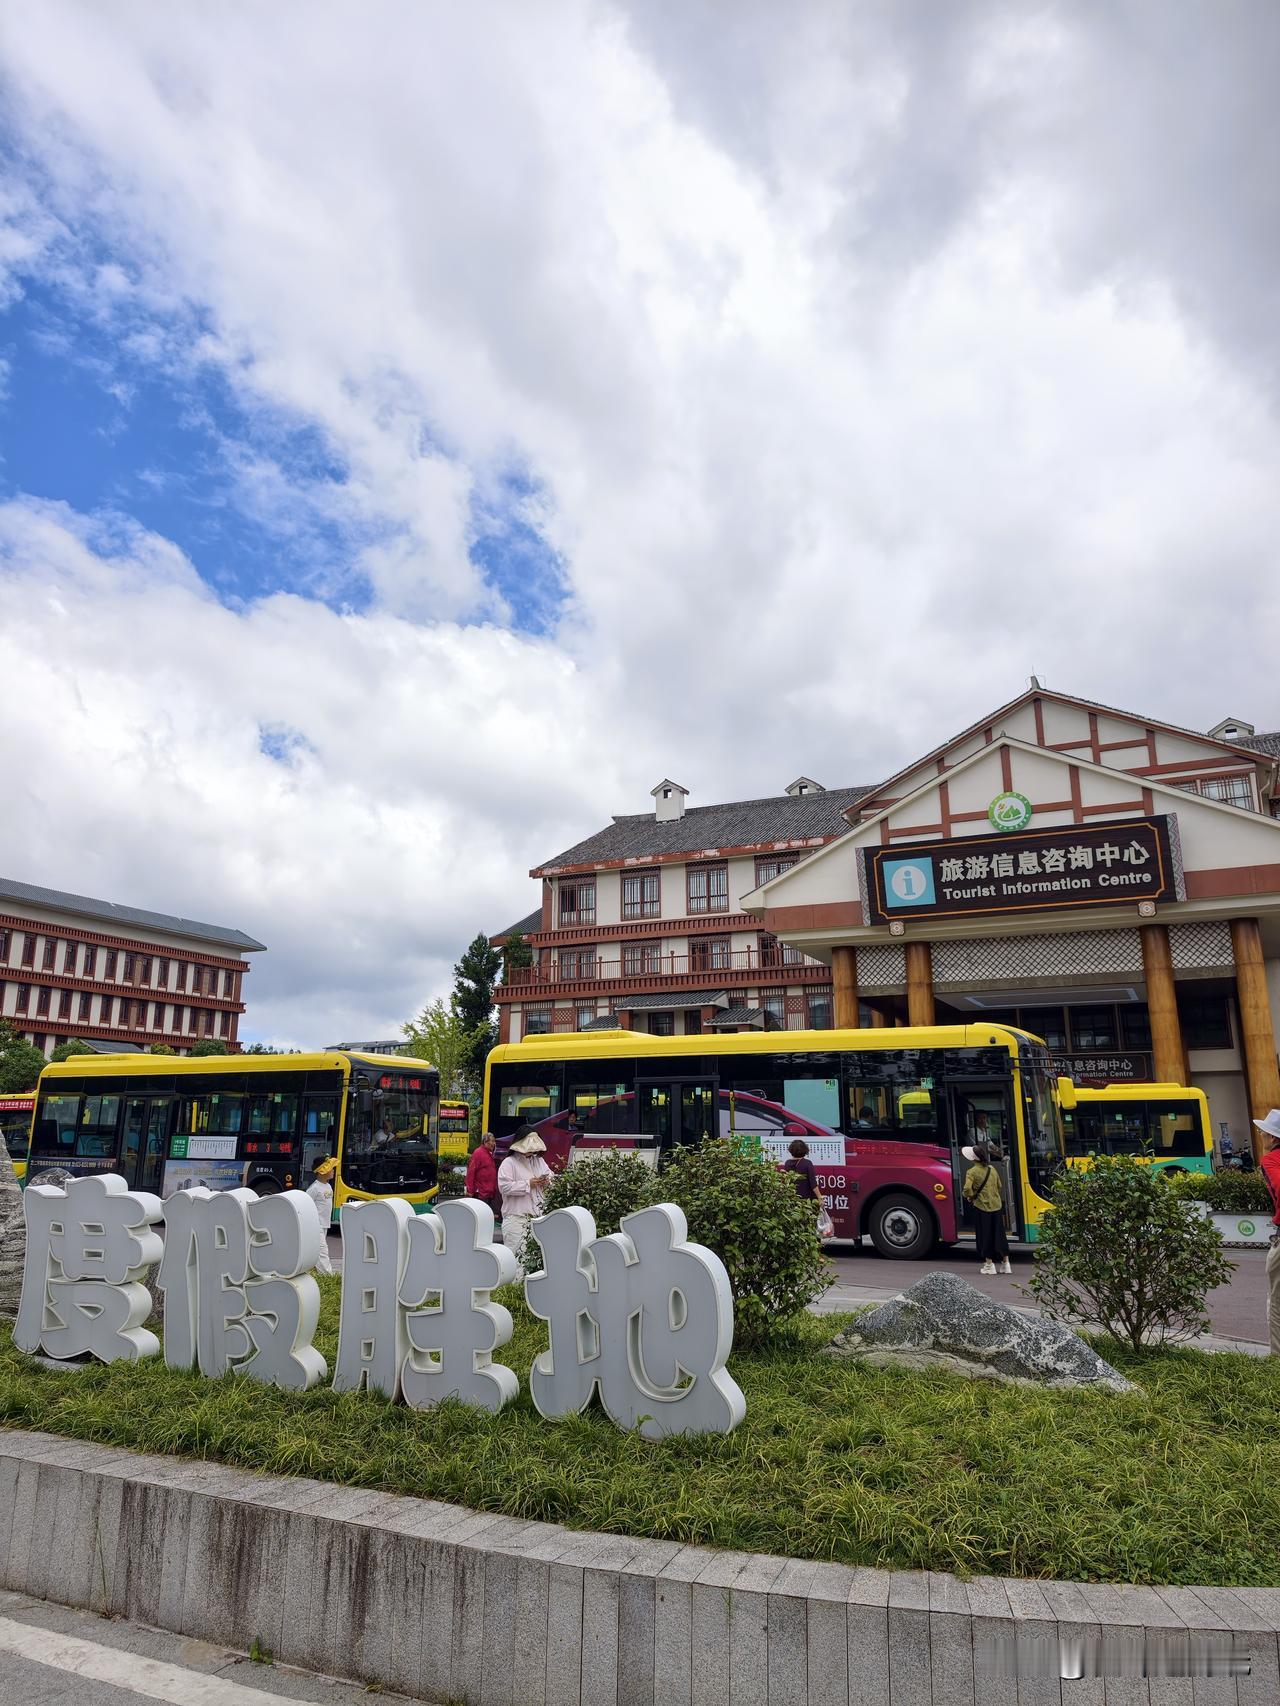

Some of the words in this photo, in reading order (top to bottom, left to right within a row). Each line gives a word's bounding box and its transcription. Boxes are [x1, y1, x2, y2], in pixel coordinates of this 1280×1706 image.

[940, 840, 1150, 883] 旅游信息咨询中心
[943, 885, 996, 900] Tourist
[1002, 877, 1091, 895] Information
[1098, 871, 1152, 887] Centre
[12, 1174, 746, 1440] 度假胜地
